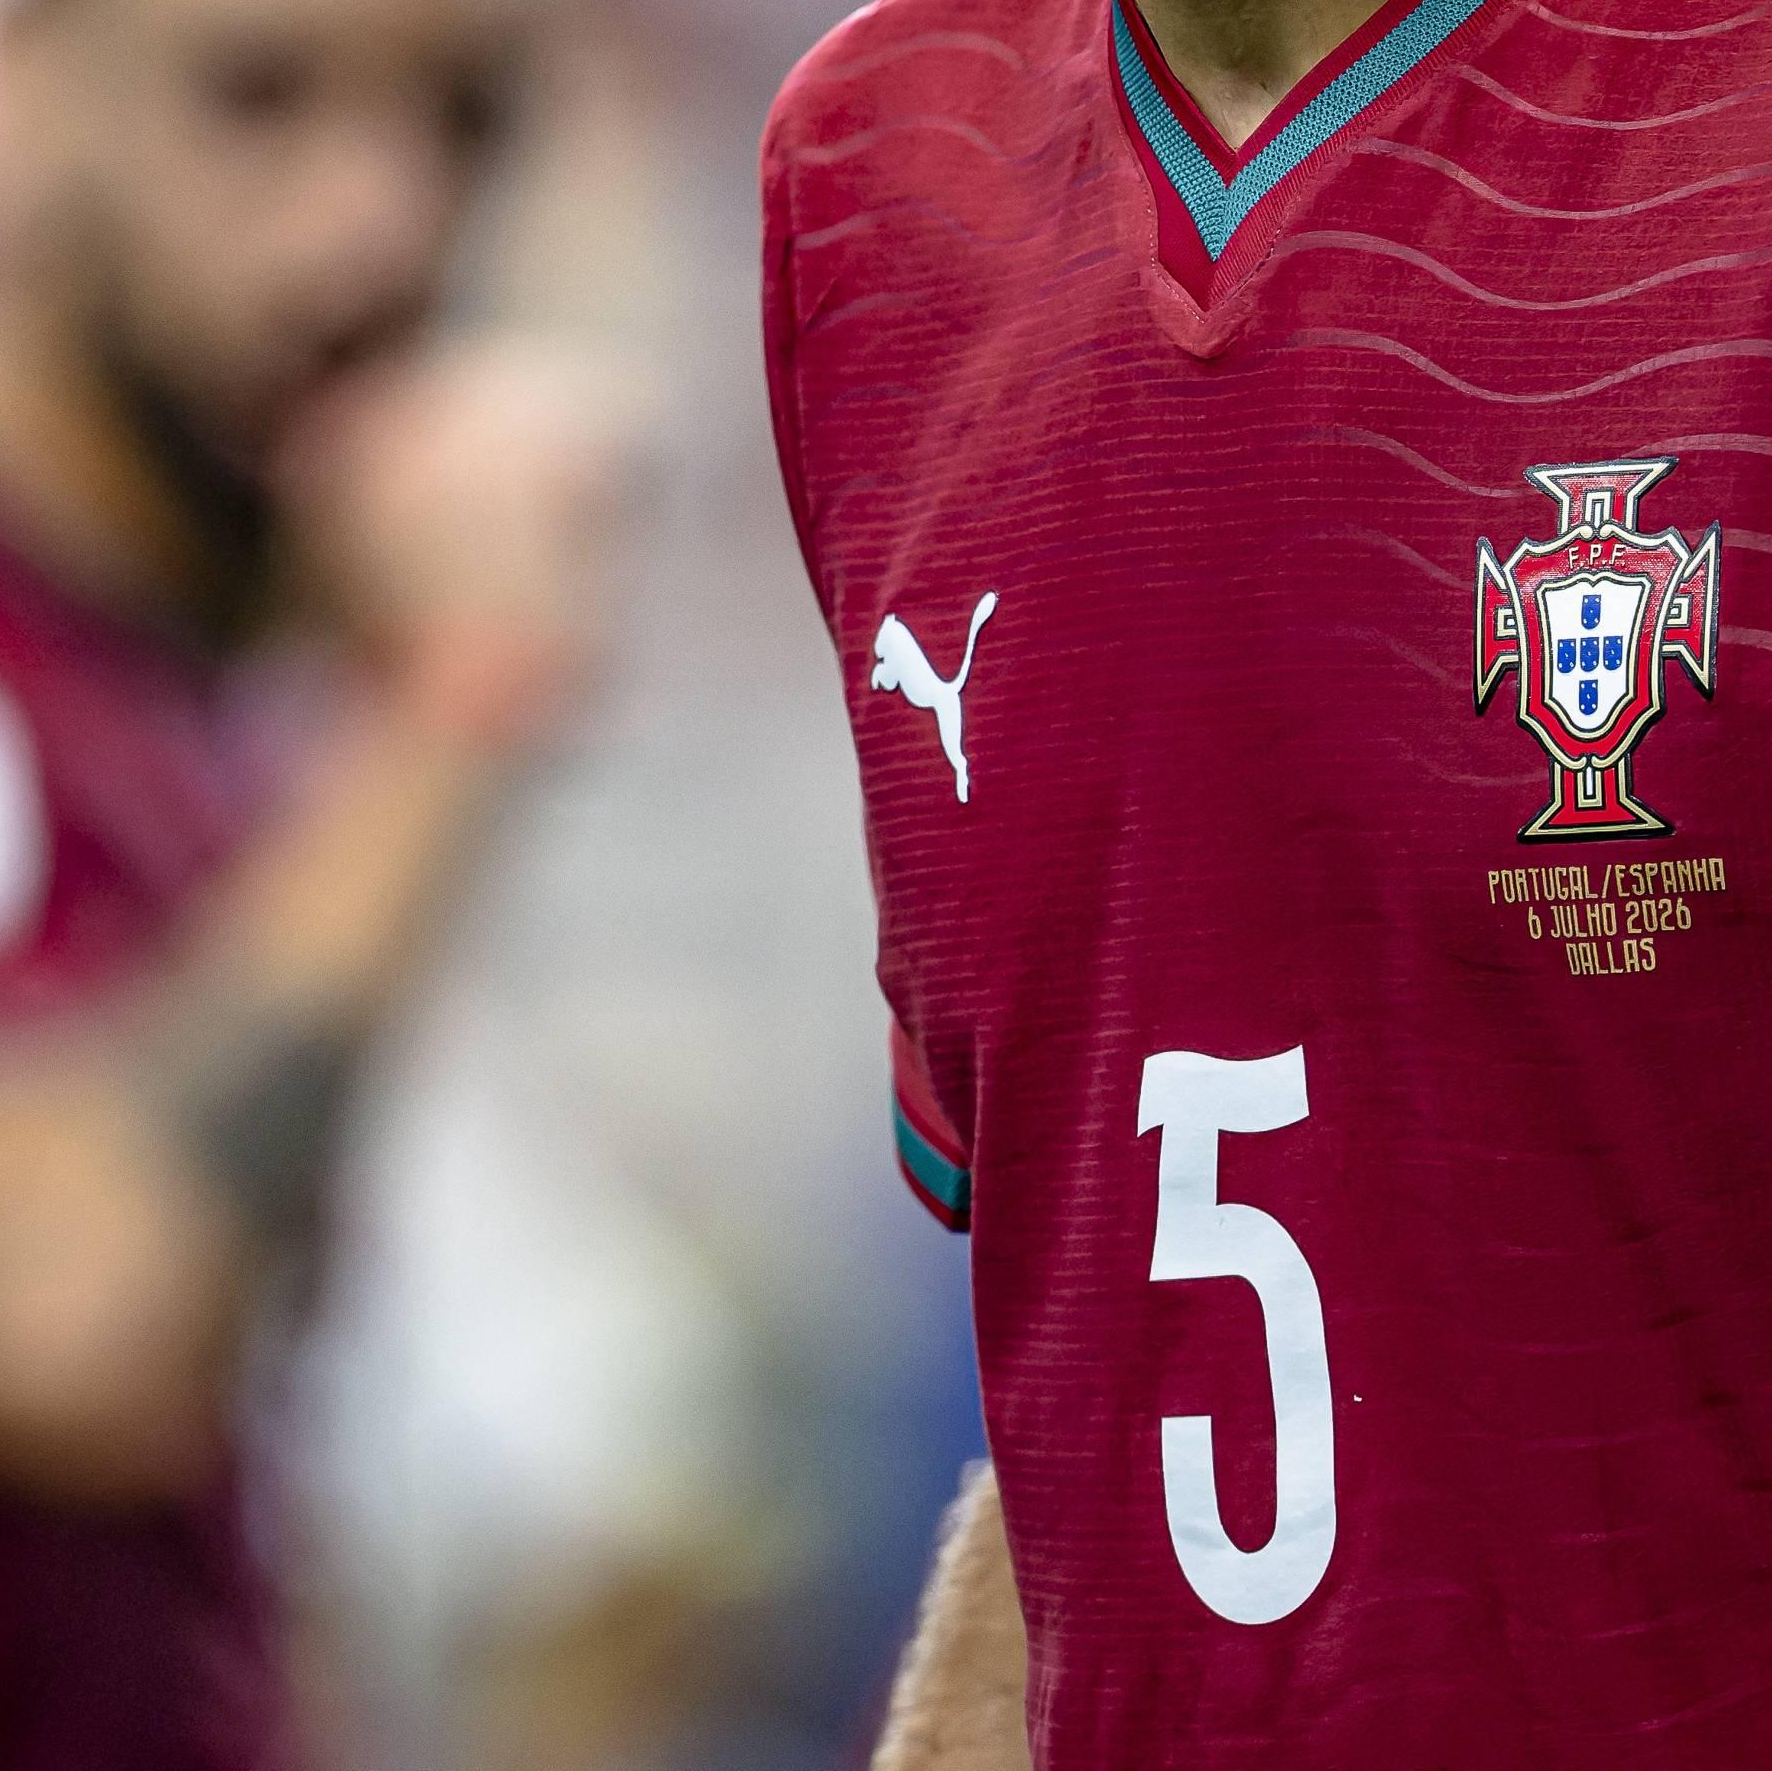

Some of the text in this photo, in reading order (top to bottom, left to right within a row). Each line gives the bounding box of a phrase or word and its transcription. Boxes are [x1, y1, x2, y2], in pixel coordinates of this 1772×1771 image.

[1528, 897, 1692, 940] 6 JULHO 2026
[1565, 937, 1657, 976] DALLAS
[1137, 1044, 1337, 1626] 5
